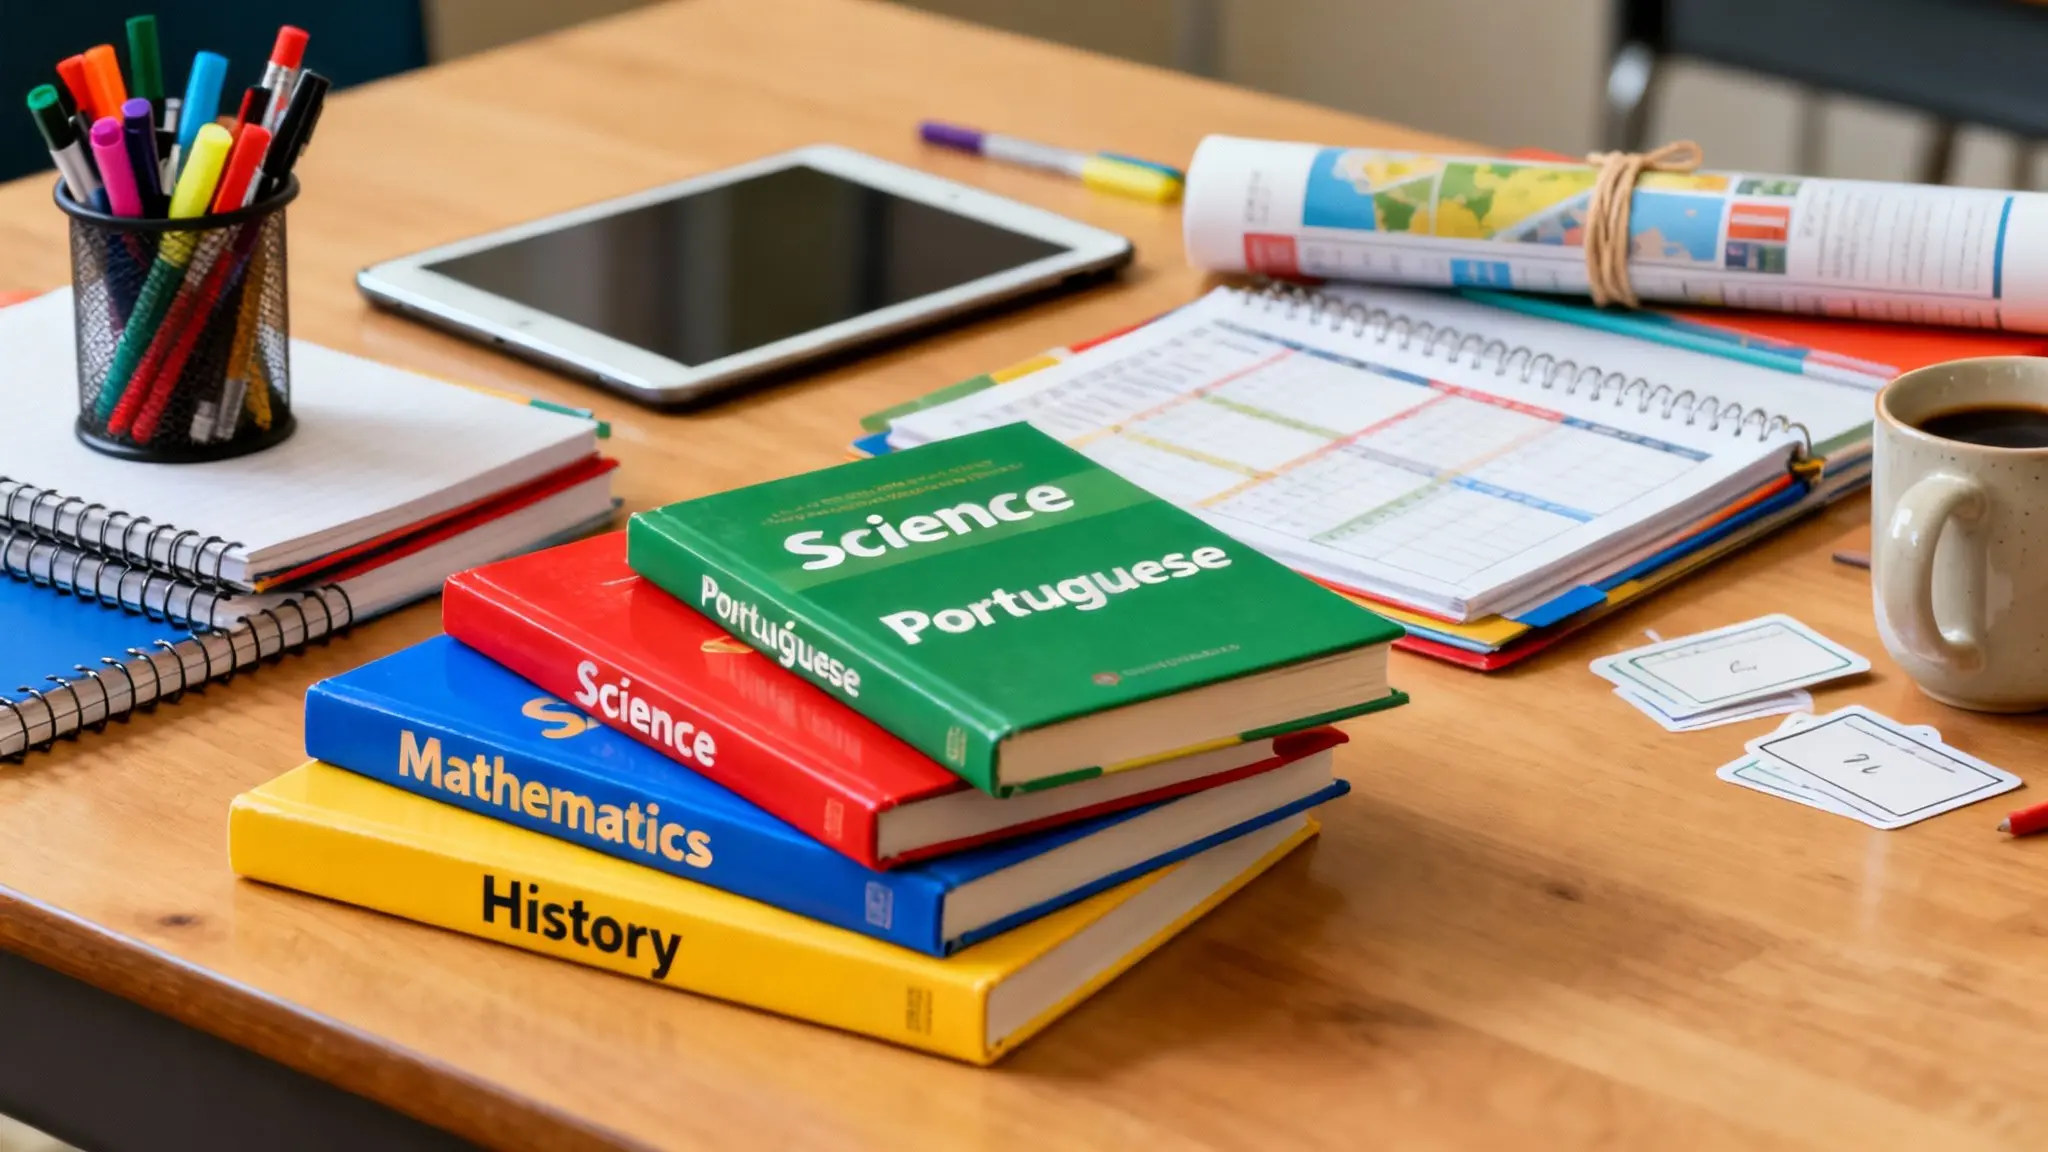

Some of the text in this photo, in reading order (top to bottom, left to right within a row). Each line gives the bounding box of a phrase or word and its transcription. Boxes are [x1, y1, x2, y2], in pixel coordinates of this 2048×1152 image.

[783, 485, 1075, 571] Science
[878, 543, 1233, 645] Portuguese
[575, 660, 717, 767] Science
[397, 730, 713, 869] Mathematics
[482, 874, 682, 980] History
